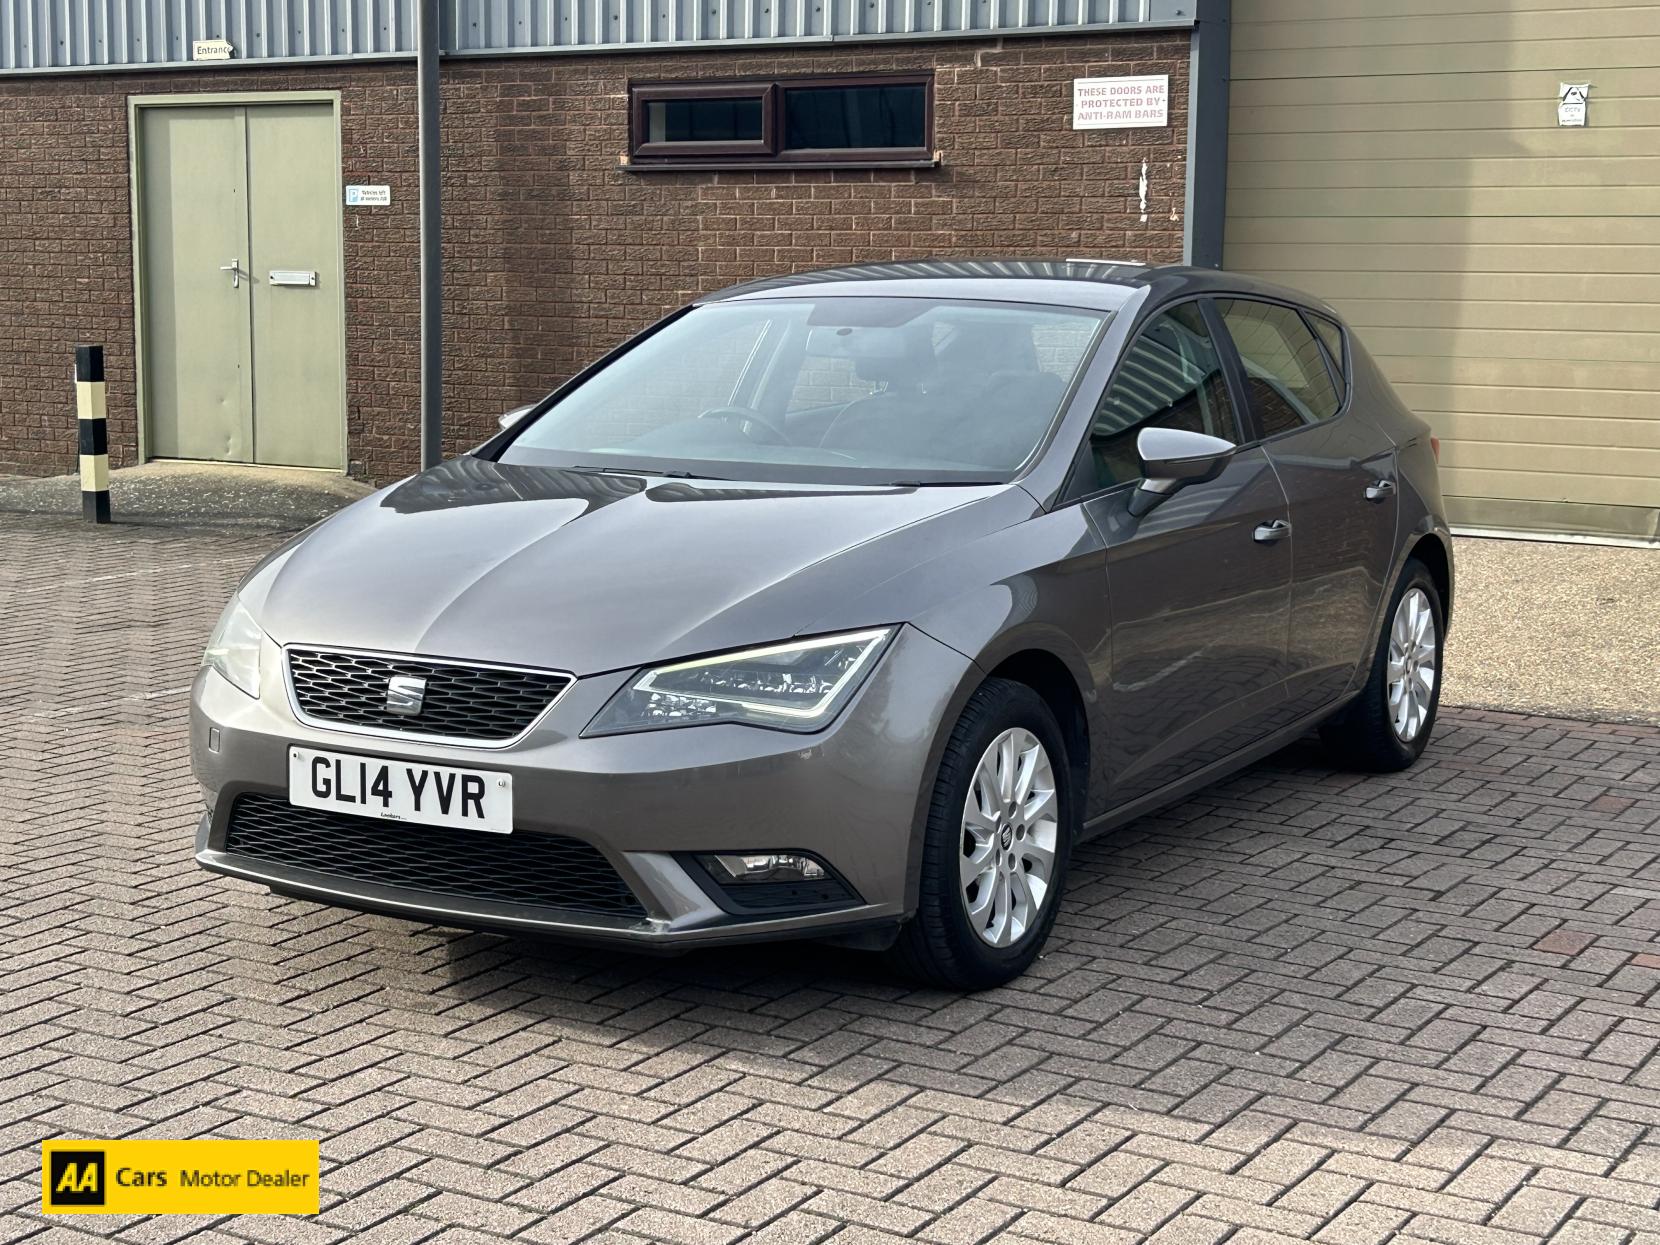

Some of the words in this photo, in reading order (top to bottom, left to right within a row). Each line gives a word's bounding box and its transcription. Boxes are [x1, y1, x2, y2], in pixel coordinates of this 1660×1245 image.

[1077, 87, 1107, 97] THESE
[1110, 86, 1142, 95] DOORS
[1145, 85, 1165, 94] ARE
[1081, 98, 1143, 109] PROTECTED
[1146, 97, 1160, 106] BY
[1078, 110, 1132, 120] ANTI-RAM
[1134, 109, 1164, 119] BARS
[311, 756, 393, 808] GL14
[406, 768, 486, 819] YVR
